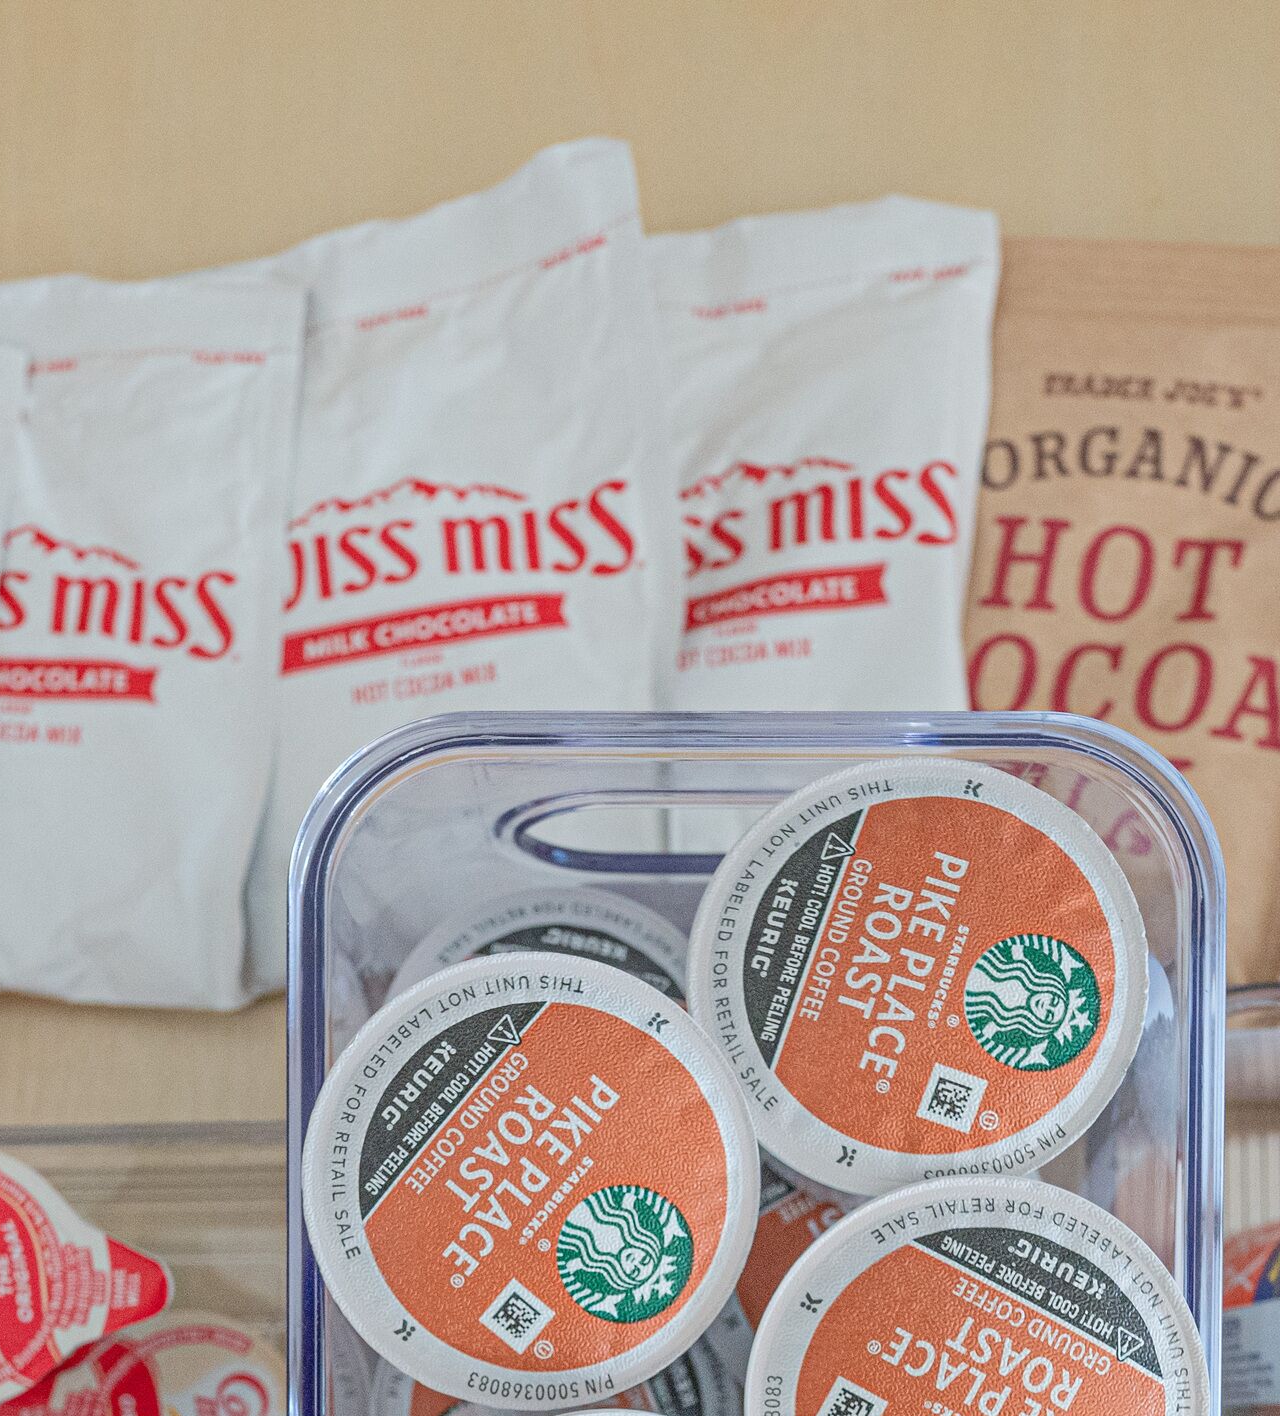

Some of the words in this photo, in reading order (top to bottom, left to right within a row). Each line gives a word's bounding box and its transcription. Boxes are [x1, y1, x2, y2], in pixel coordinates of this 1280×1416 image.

[1044, 372, 1156, 401] TRADER
[978, 514, 1246, 624] HOT
[303, 630, 368, 660] MILK
[374, 600, 538, 647] CHOCOLATE
[751, 878, 798, 978] KEURIG
[827, 859, 872, 943] GROUND
[908, 850, 970, 942] PIKE
[799, 948, 840, 1021] COFFEE
[837, 882, 897, 1020] ROAST
[932, 925, 970, 1021] STARBUCKS
[859, 947, 938, 1084] PLACE
[381, 1040, 456, 1130] KEURIG
[535, 1074, 620, 1166] PIKE
[444, 1085, 556, 1212] ROAST
[442, 1158, 550, 1276] PLACE
[525, 1156, 594, 1240] STARBUCKS
[1009, 1238, 1107, 1299] KEURIG
[467, 1372, 579, 1401] 5000368083
[581, 1372, 614, 1391] P/N
[945, 1317, 1084, 1411] ROAST
